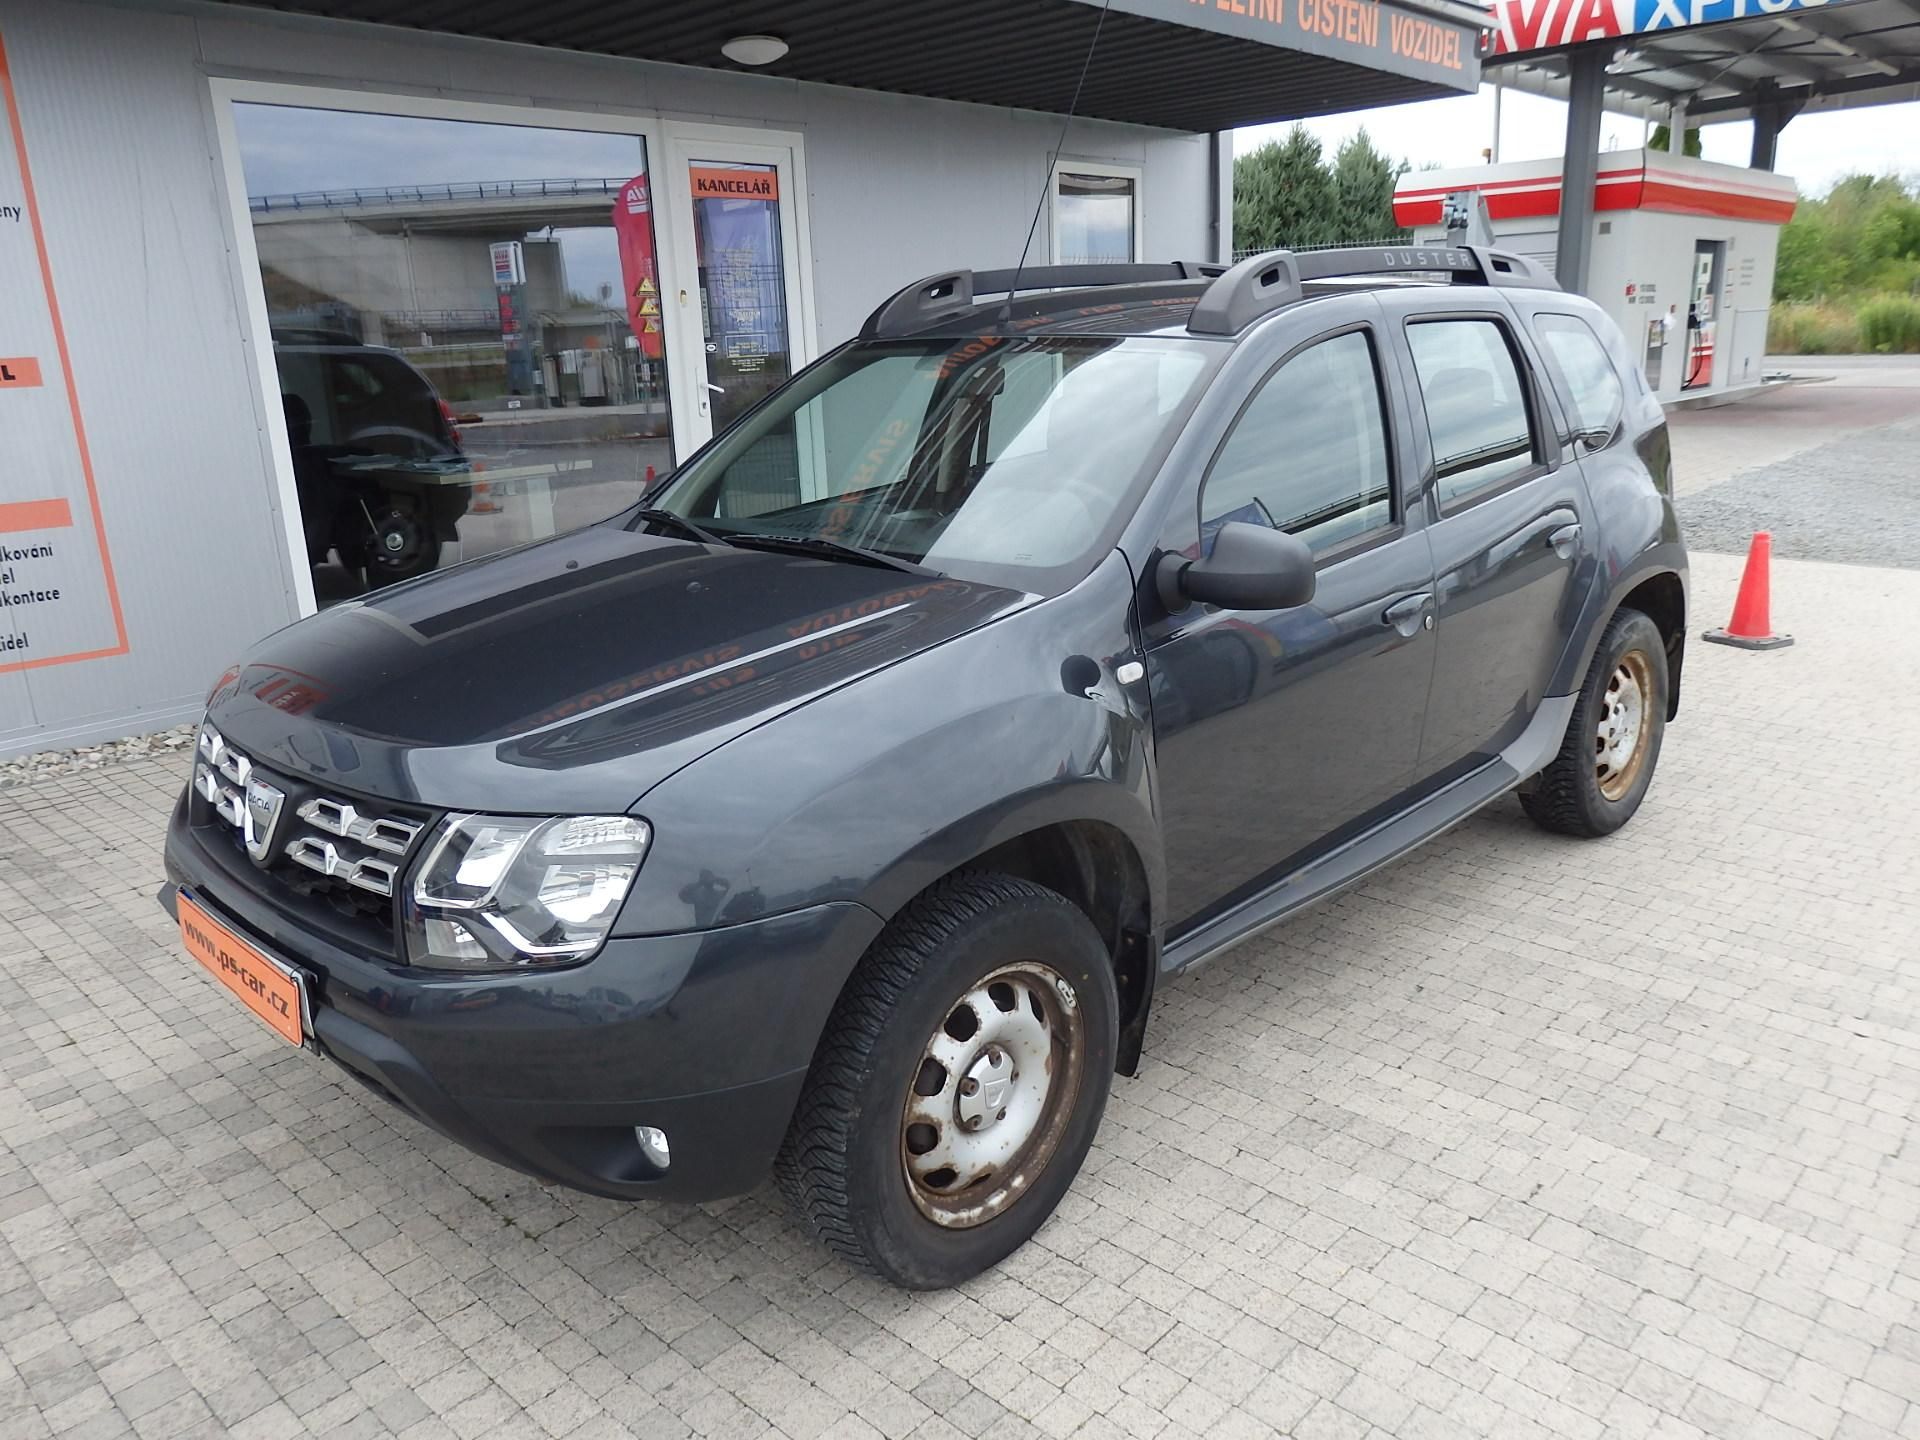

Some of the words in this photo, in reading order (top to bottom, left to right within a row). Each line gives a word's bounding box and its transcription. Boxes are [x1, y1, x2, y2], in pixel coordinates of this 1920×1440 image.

[1391, 13, 1463, 70] VOZIDEL
[697, 178, 771, 195] KANCELÁŘ
[0, 206, 21, 223] ny
[1384, 251, 1472, 267] DUSTER
[0, 541, 54, 562] kování
[0, 567, 15, 585] el
[0, 589, 61, 608] kontace
[0, 631, 30, 653] idel
[247, 791, 271, 811] DACIA
[183, 918, 291, 1020] www.ps-car.cz
